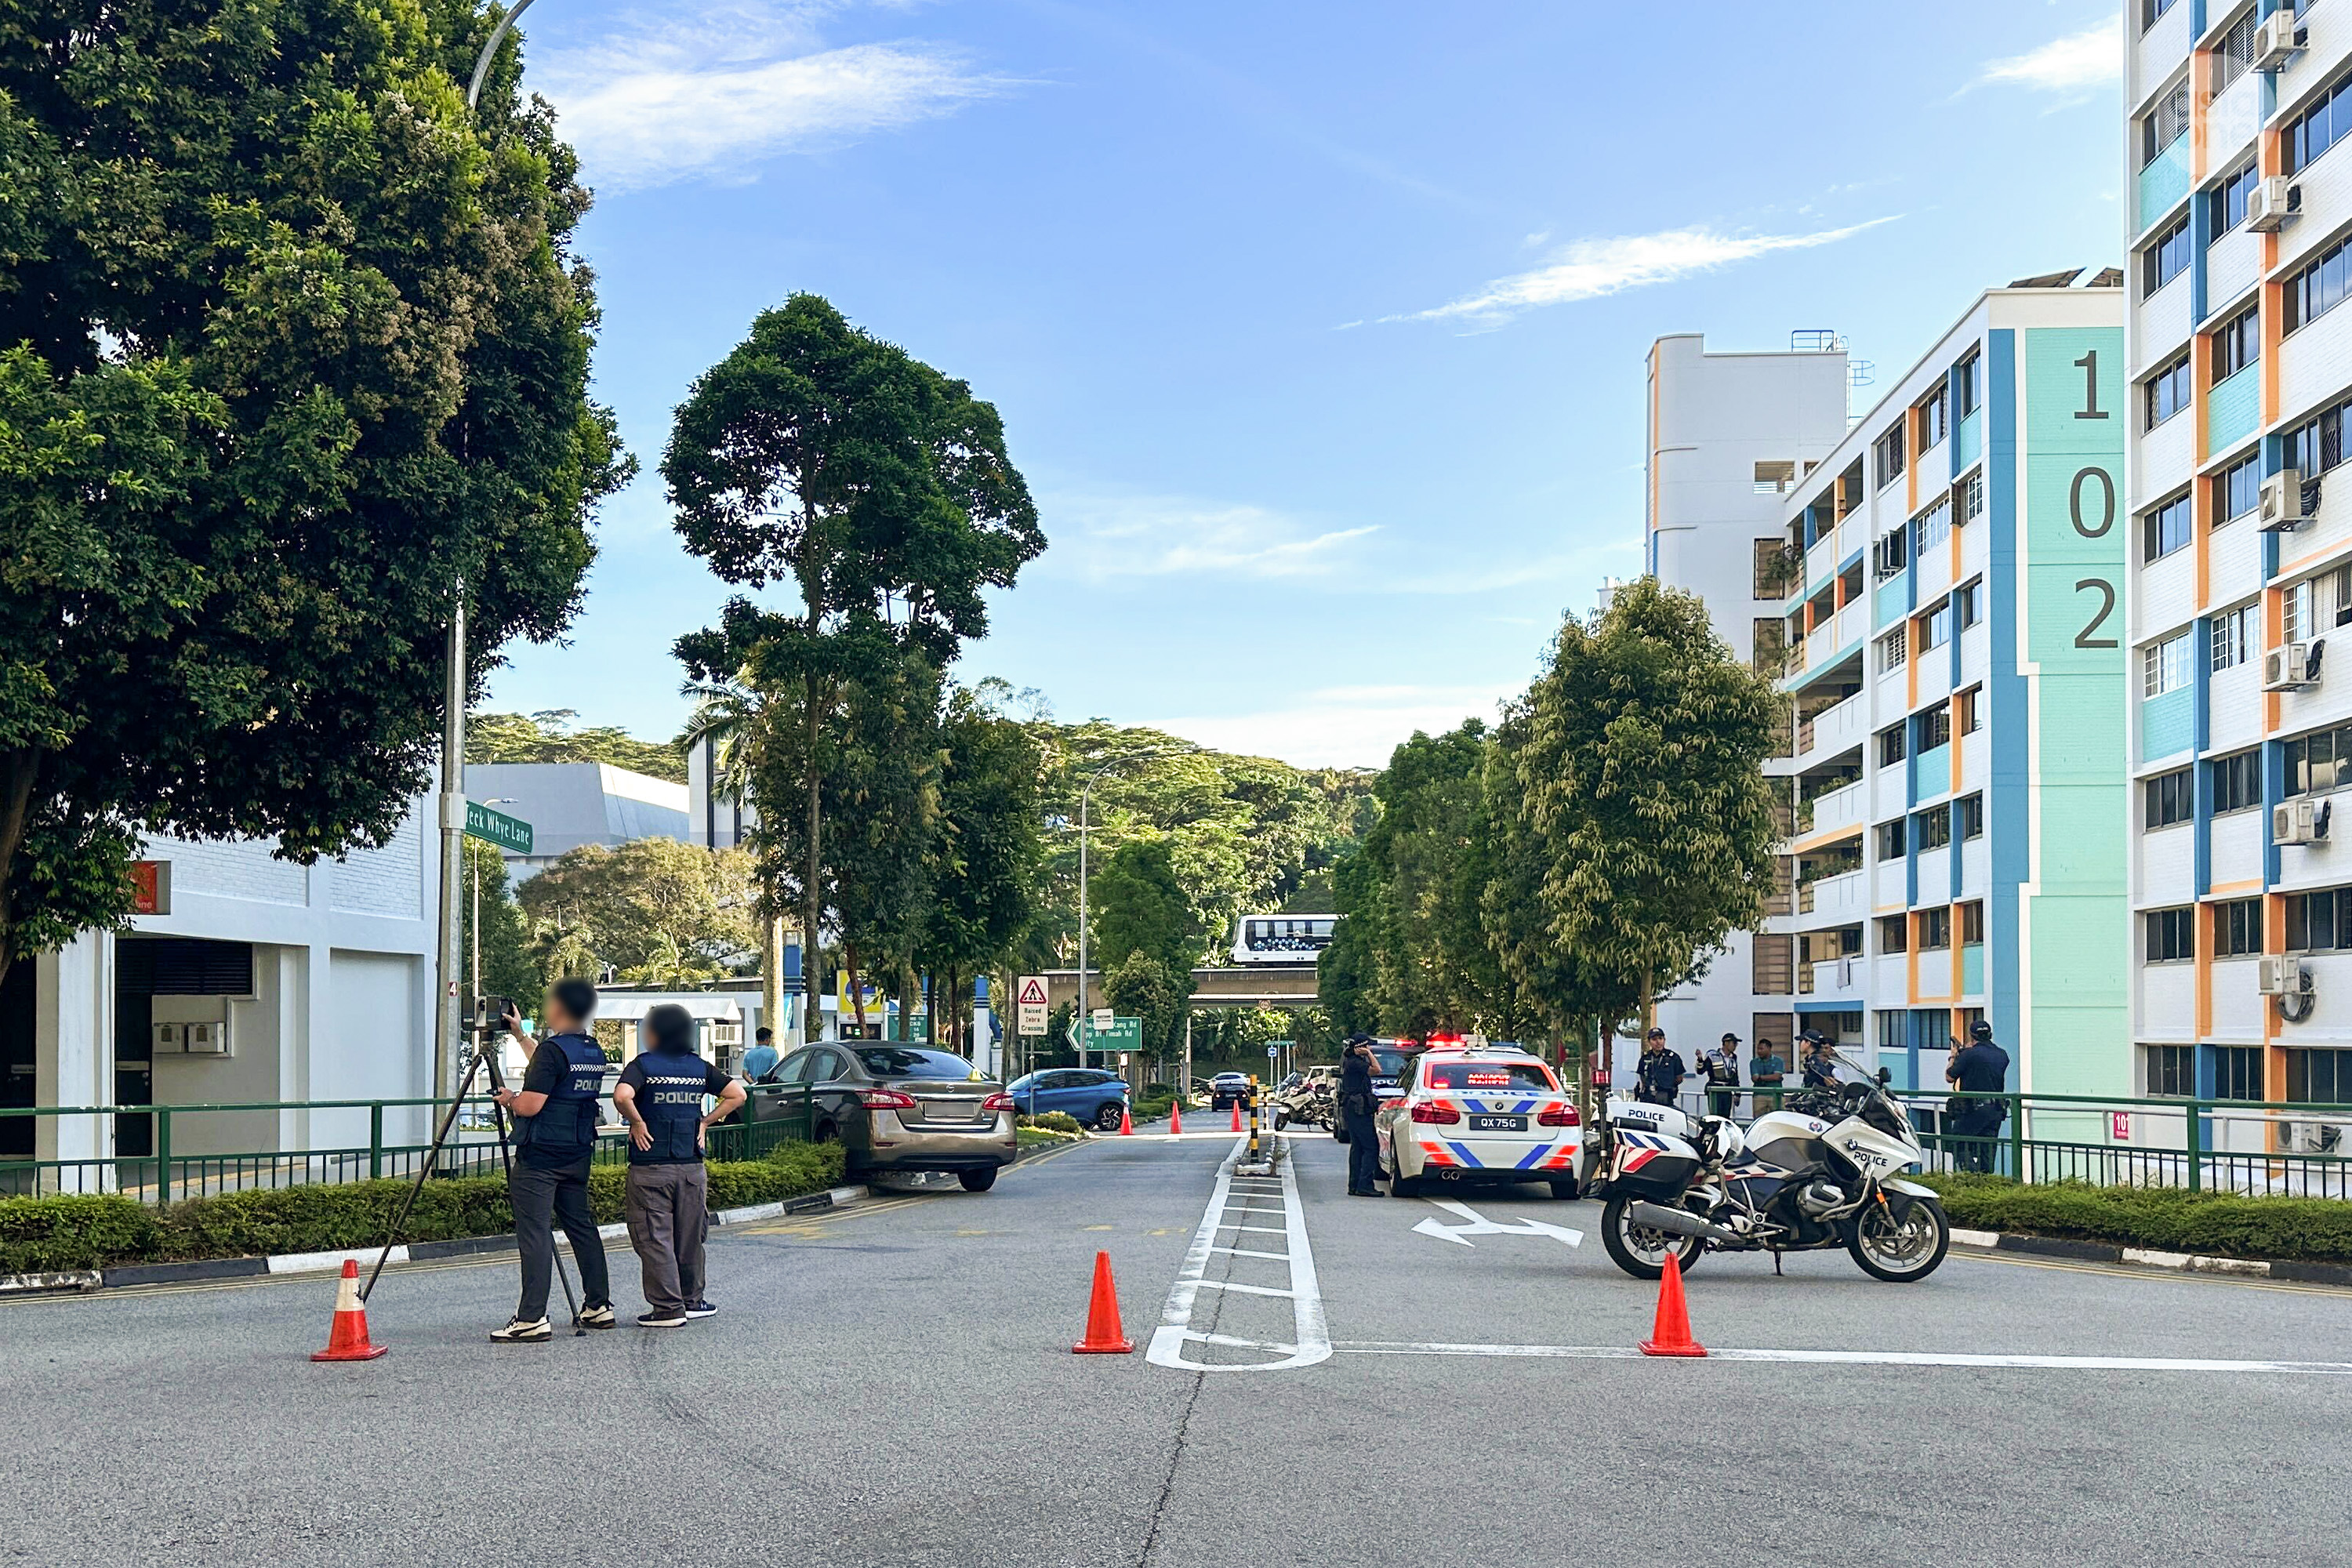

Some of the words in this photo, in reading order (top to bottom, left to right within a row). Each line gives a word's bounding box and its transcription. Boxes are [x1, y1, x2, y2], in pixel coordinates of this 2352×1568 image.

[2070, 350, 2118, 649] 102
[487, 812, 510, 840] Whye
[511, 822, 529, 845] Lane
[449, 982, 457, 996] 4
[653, 1092, 702, 1104] POLICE
[1481, 1118, 1495, 1127] QX
[1497, 1118, 1516, 1127] 75G
[1628, 1109, 1665, 1122] POLICE
[1853, 1151, 1888, 1167] POLICE
